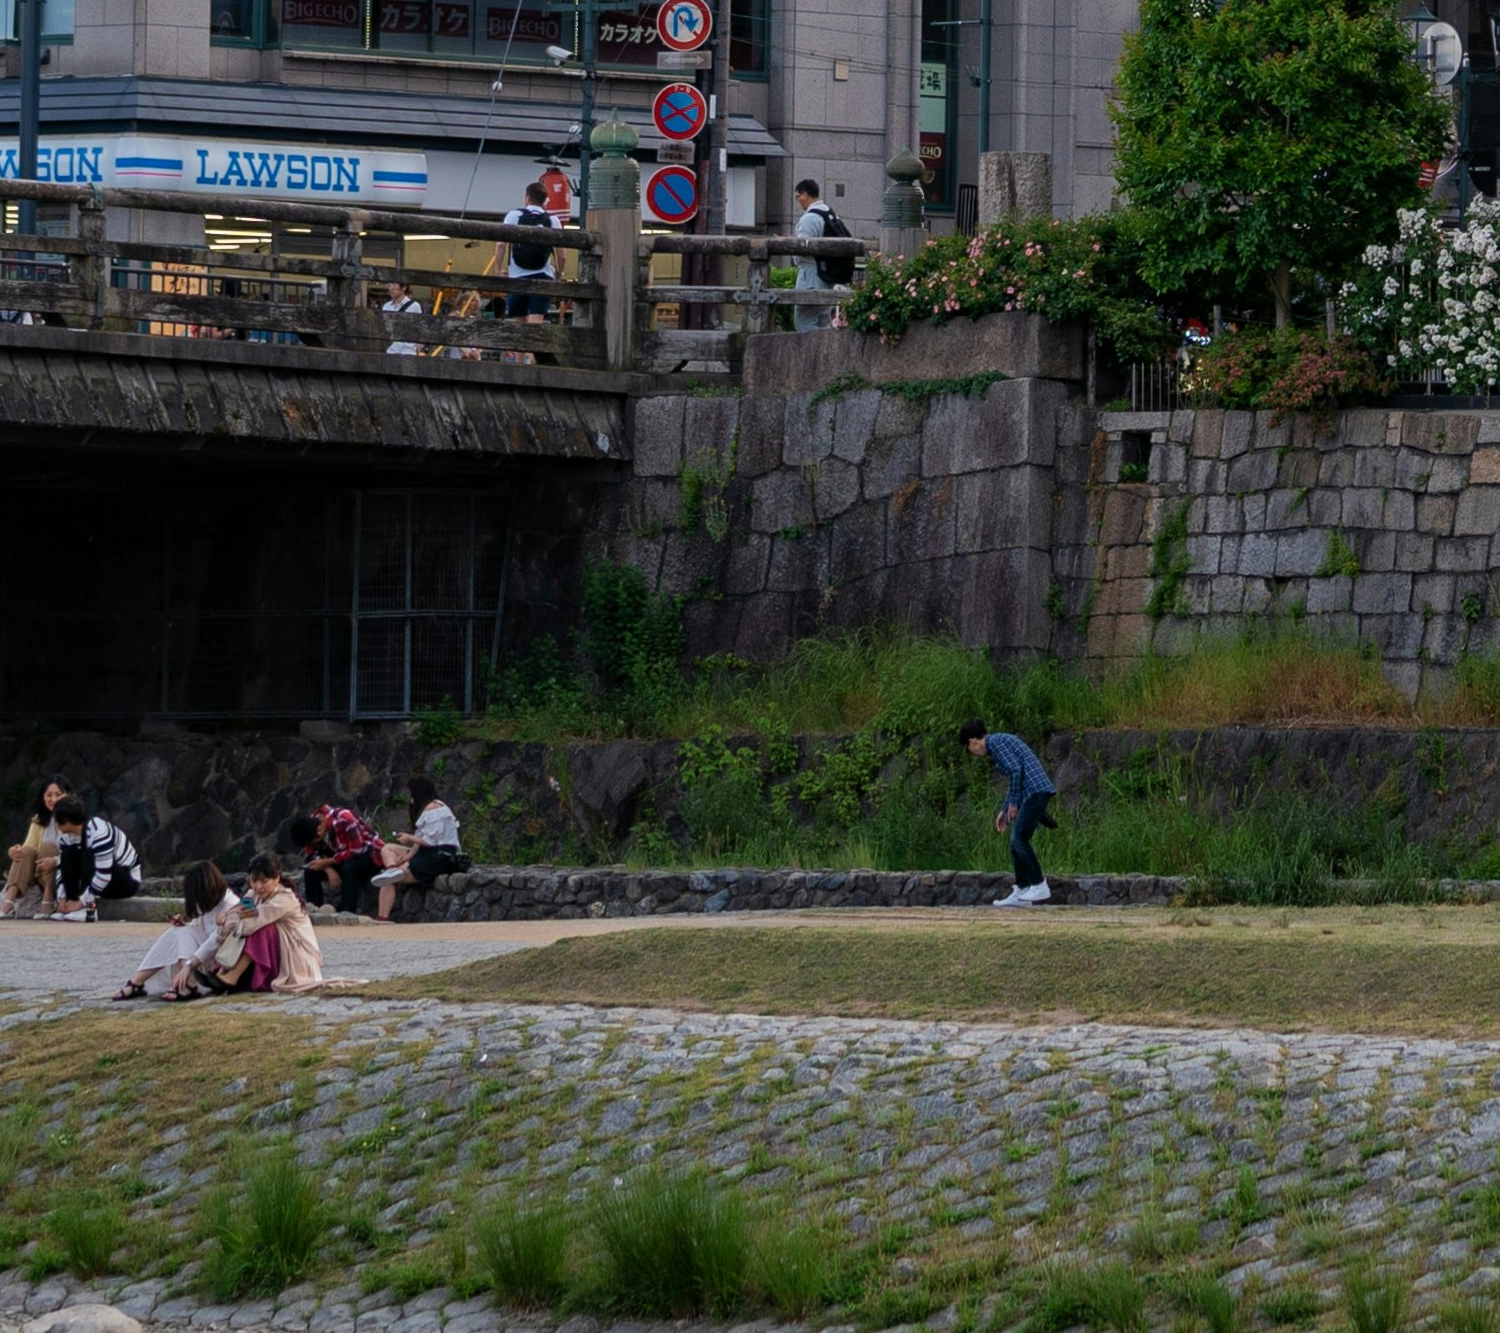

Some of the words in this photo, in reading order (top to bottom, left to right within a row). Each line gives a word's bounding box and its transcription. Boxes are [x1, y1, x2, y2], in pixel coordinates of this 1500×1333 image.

[283, 0, 314, 20] BIG
[315, 4, 357, 23] ECHO
[196, 148, 360, 193] LAWSON
